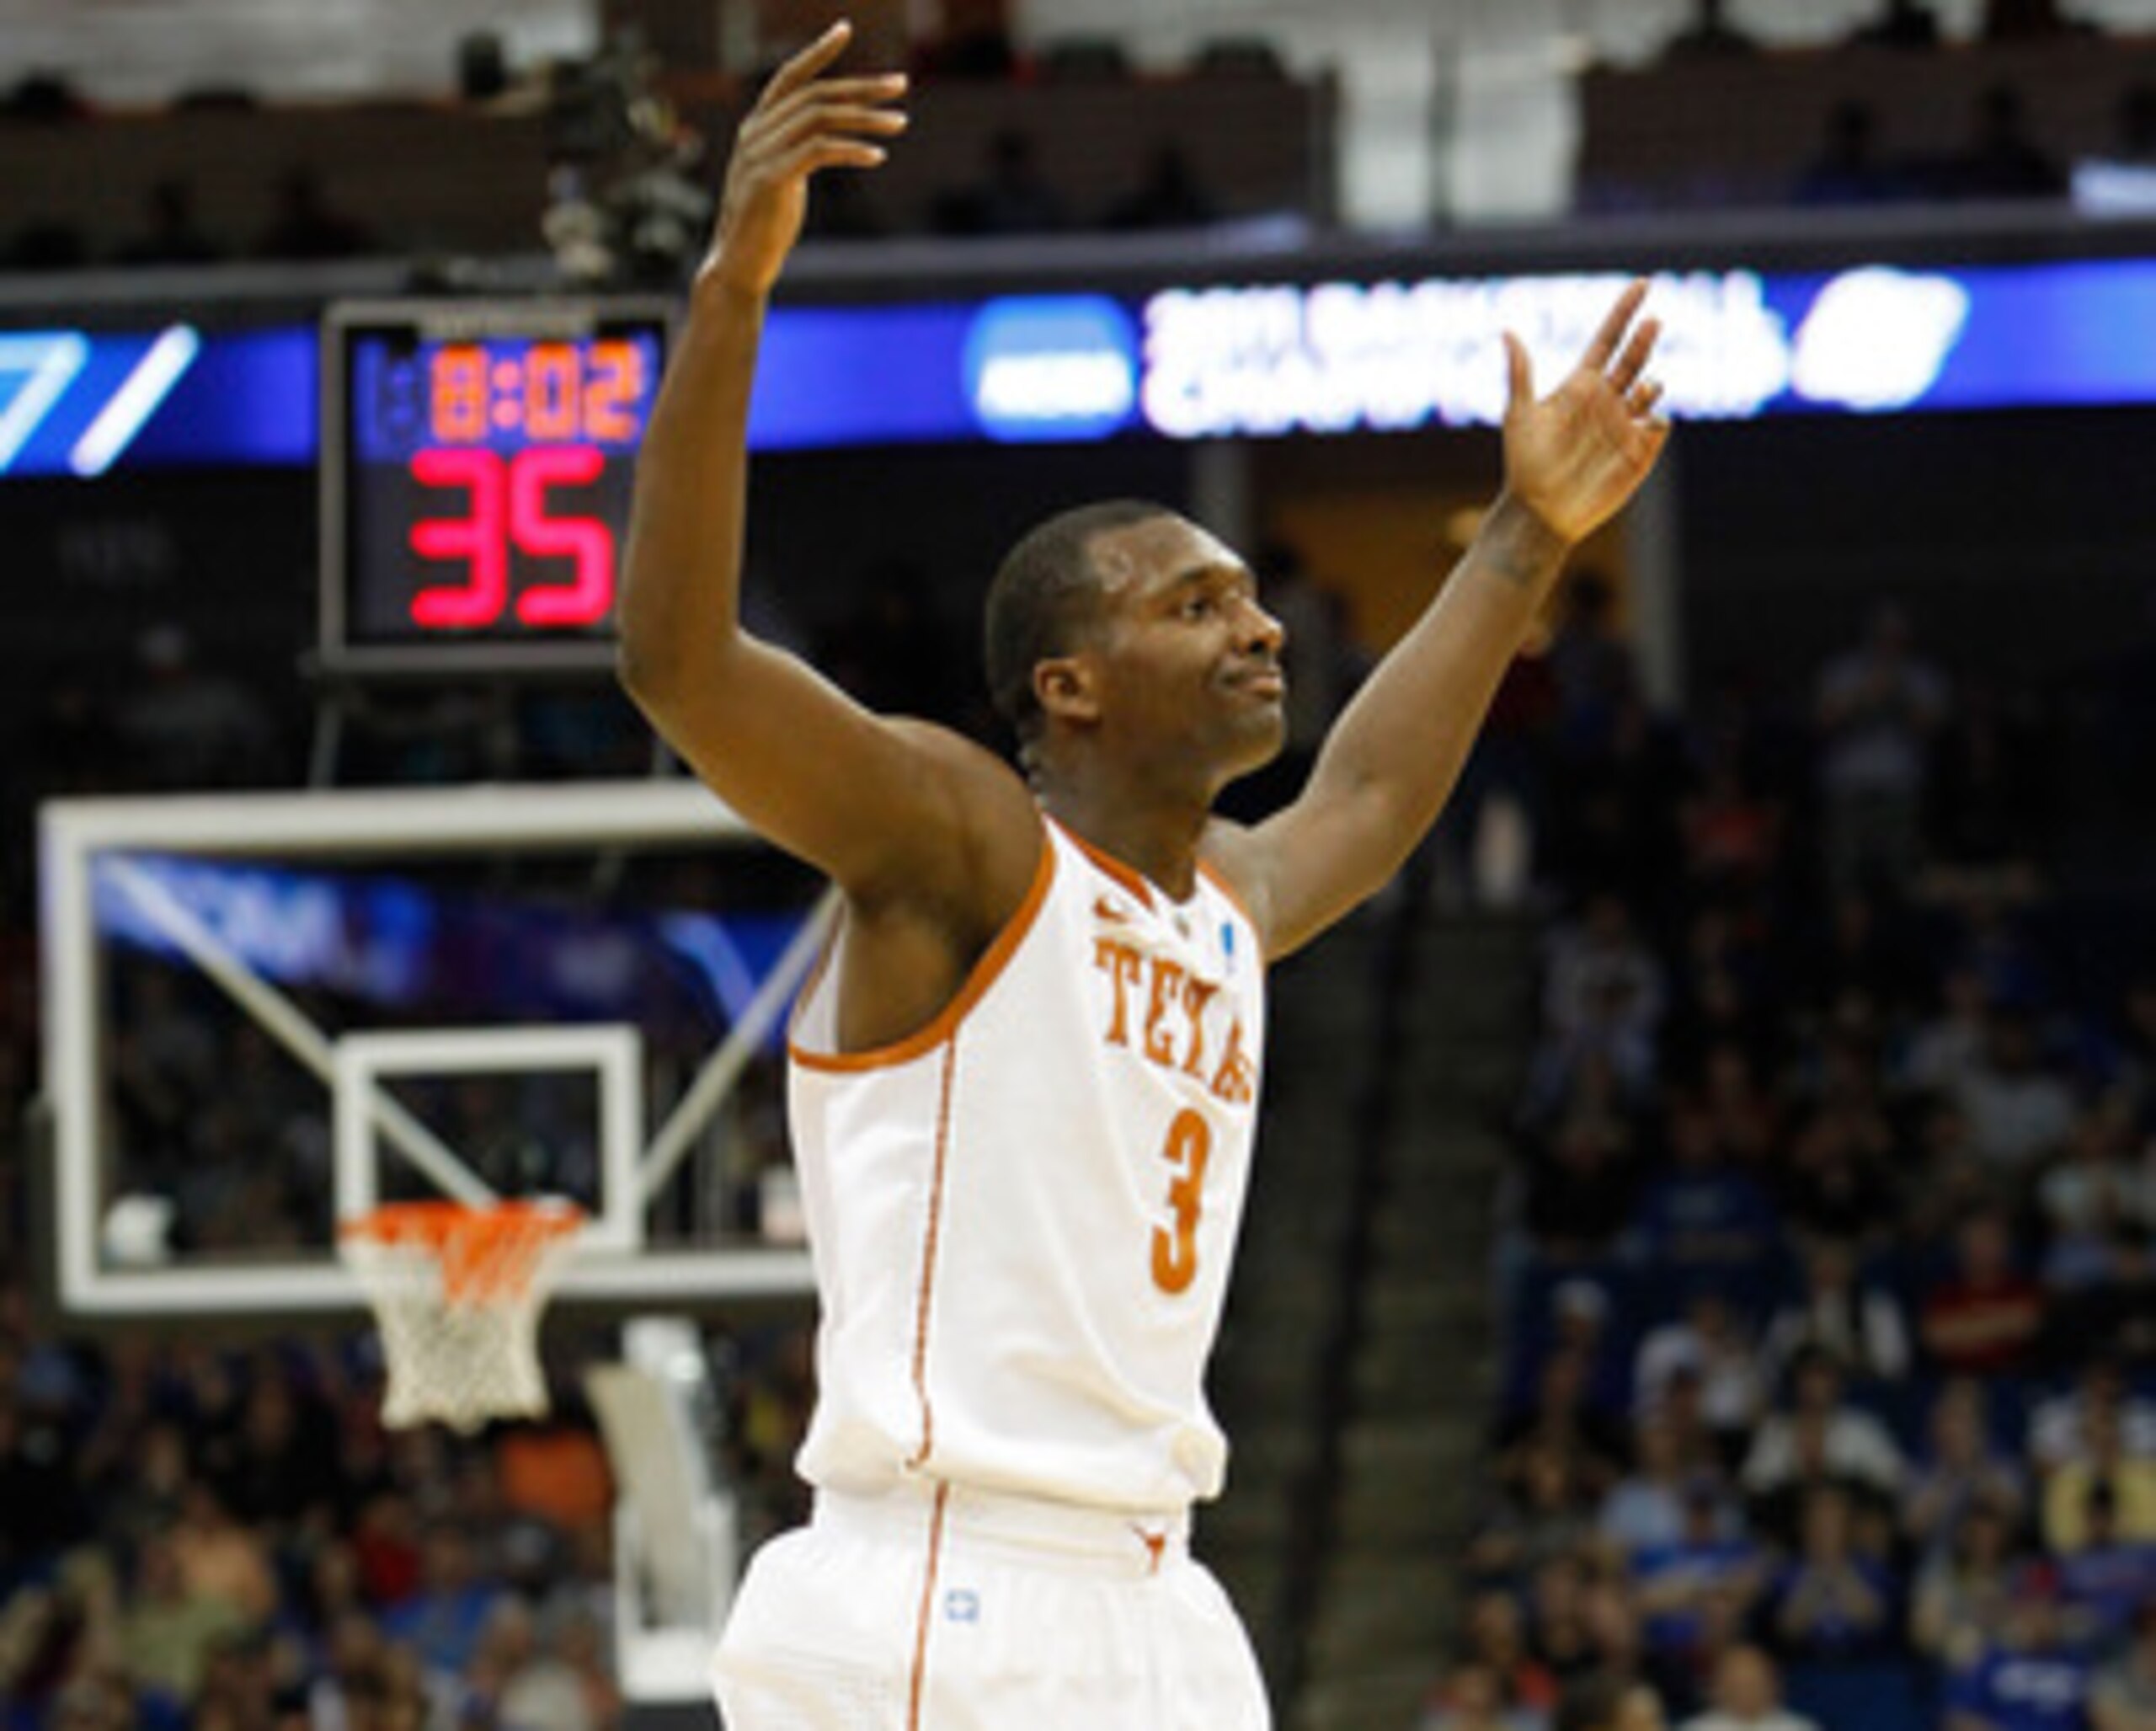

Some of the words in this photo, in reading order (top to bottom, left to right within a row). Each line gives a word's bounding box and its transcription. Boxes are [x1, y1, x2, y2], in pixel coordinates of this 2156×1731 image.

[430, 339, 642, 442] 8:02
[409, 446, 616, 628] 35
[1150, 1108, 1211, 1295] 3
